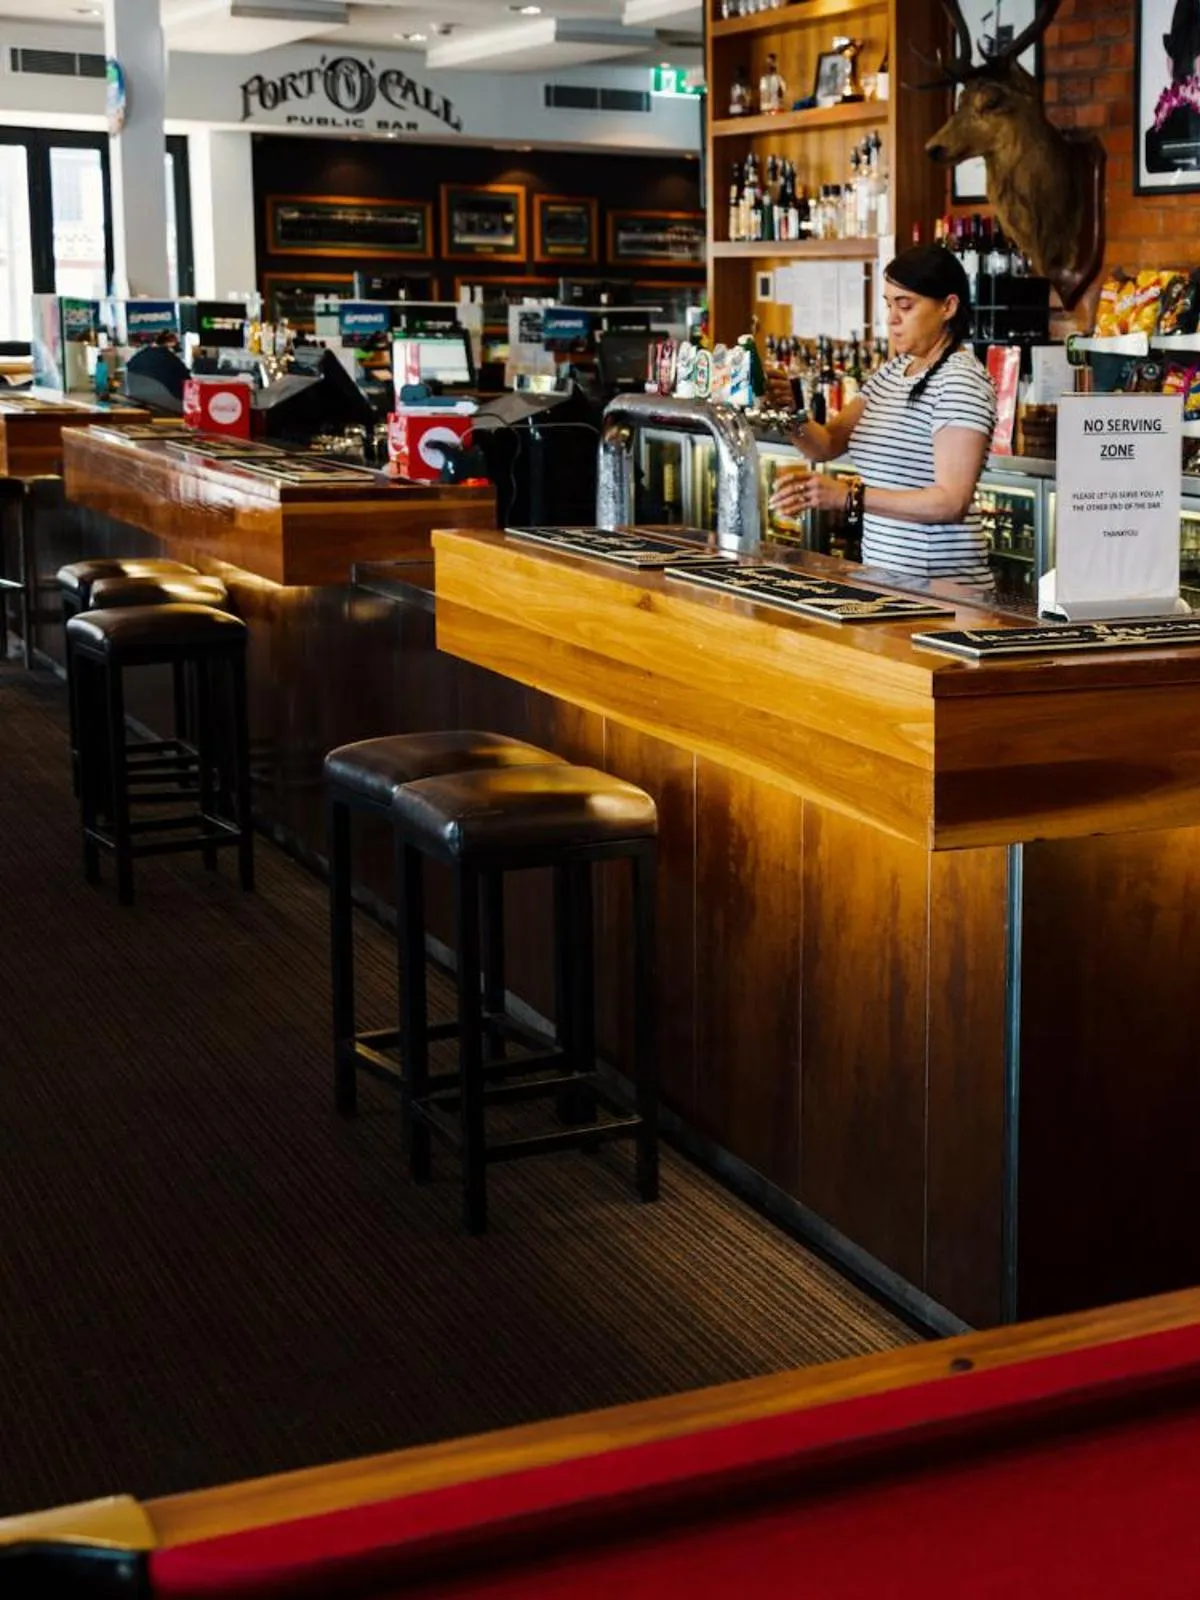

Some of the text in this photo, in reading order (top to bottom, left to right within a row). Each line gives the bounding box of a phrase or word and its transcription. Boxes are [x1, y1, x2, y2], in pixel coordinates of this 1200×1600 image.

[240, 68, 321, 122] PORT
[378, 68, 463, 132] CALL
[286, 114, 419, 131] PUBLIC BAR
[1084, 418, 1162, 433] NO SERVING
[1100, 444, 1135, 458] ZONE
[1072, 491, 1095, 500] PLEASE
[1097, 491, 1107, 499] LET
[1108, 491, 1118, 499] US
[1119, 491, 1138, 499] SERVE
[1140, 490, 1154, 498] YOU
[1086, 503, 1108, 511] OTHER
[1109, 503, 1123, 511] END
[1134, 502, 1146, 510] THE
